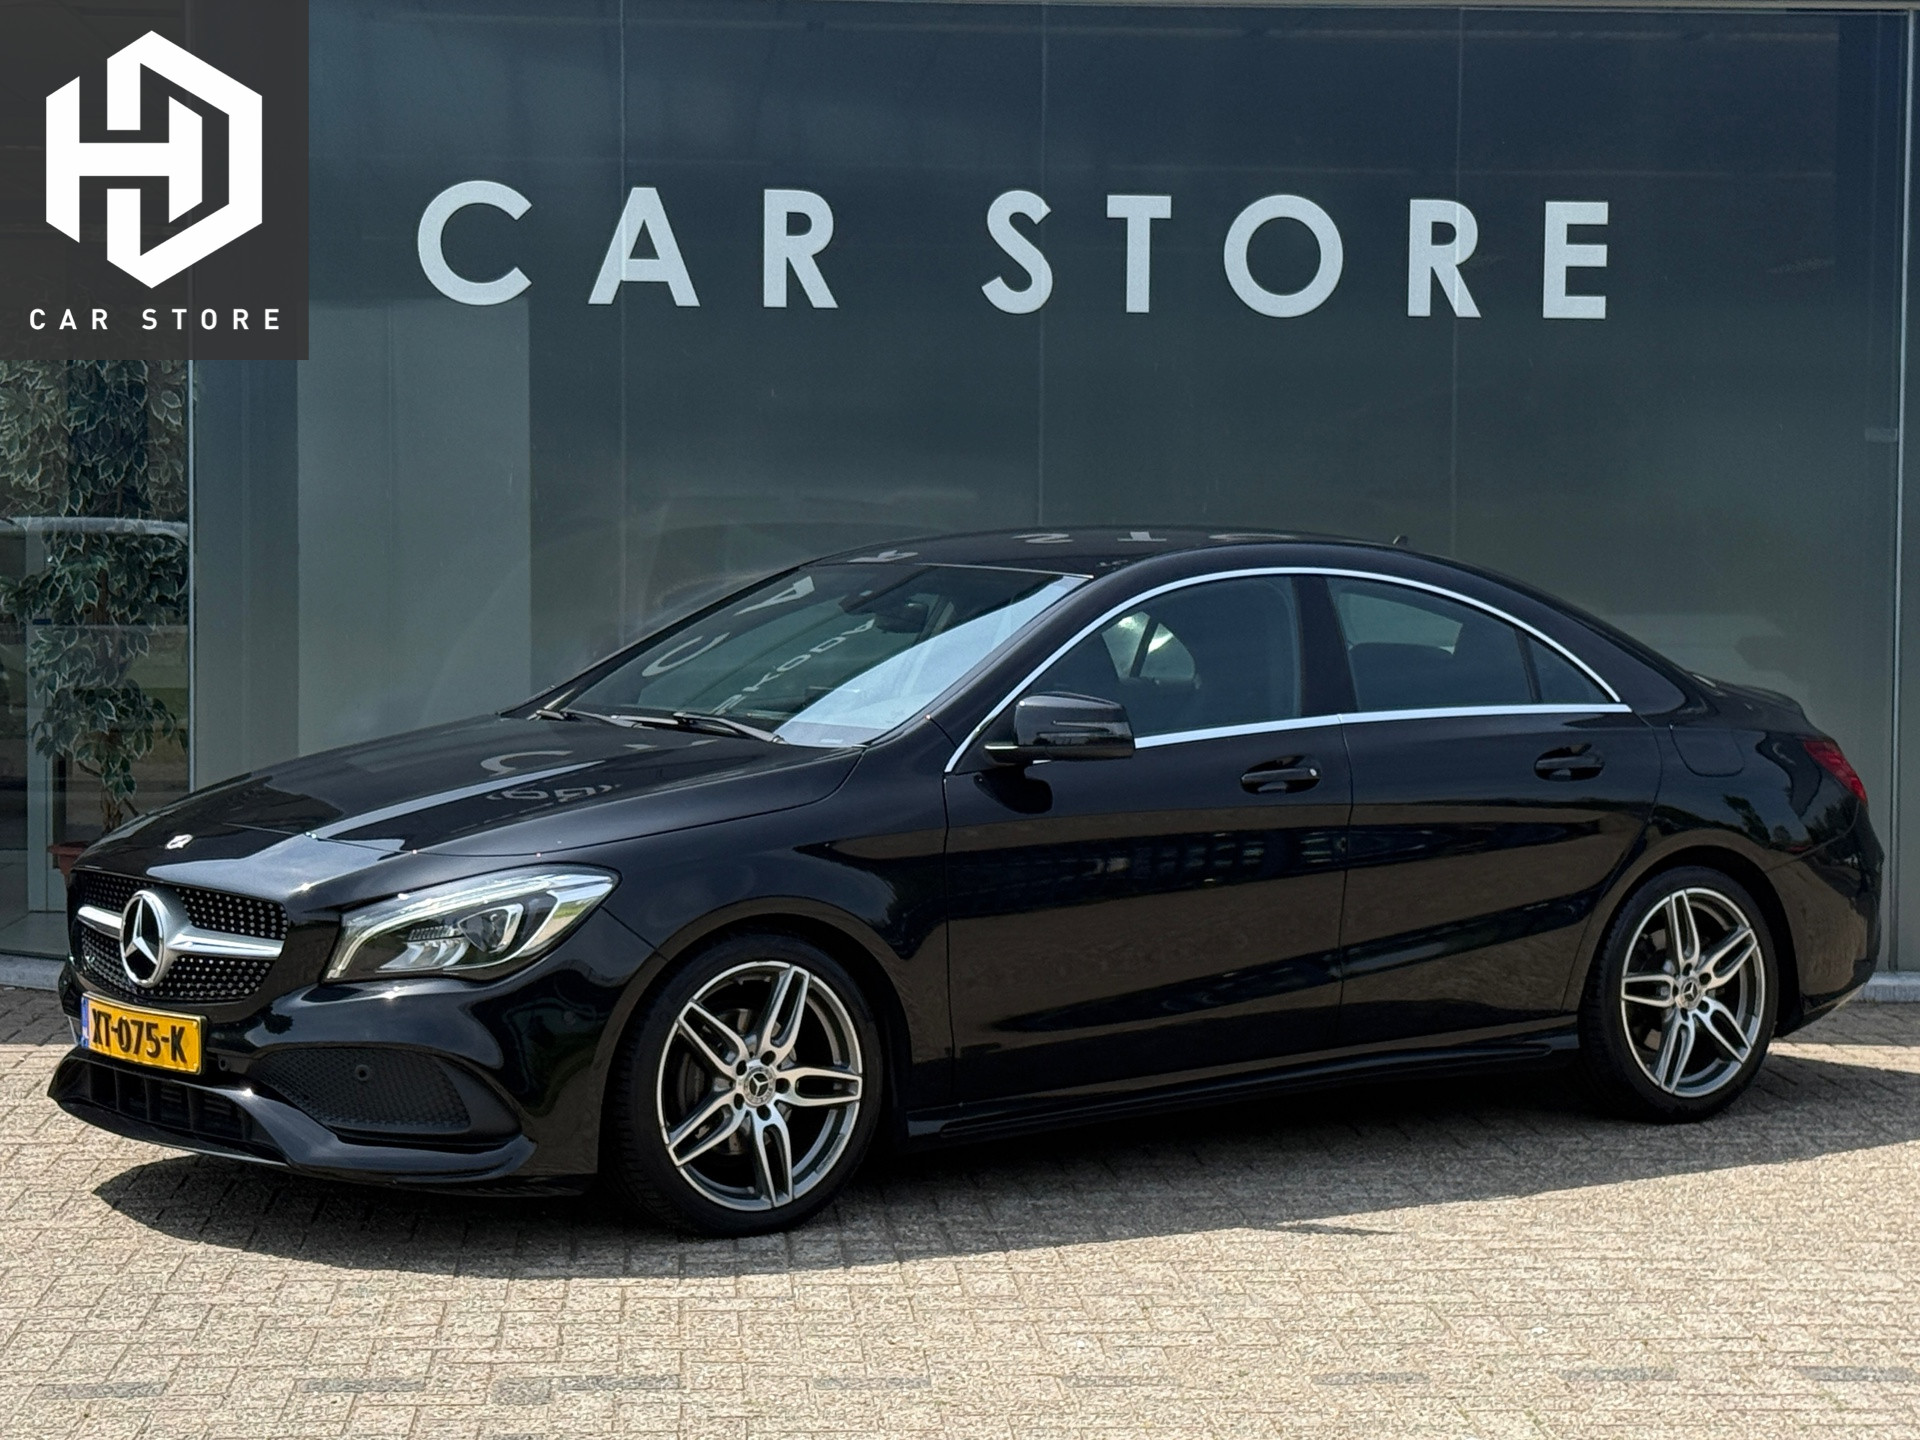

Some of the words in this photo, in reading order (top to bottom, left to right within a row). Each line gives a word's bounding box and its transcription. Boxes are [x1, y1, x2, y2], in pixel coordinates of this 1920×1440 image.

[417, 180, 838, 309] CAR
[981, 189, 1609, 319] STORE
[92, 1008, 188, 1064] XT-075-K
